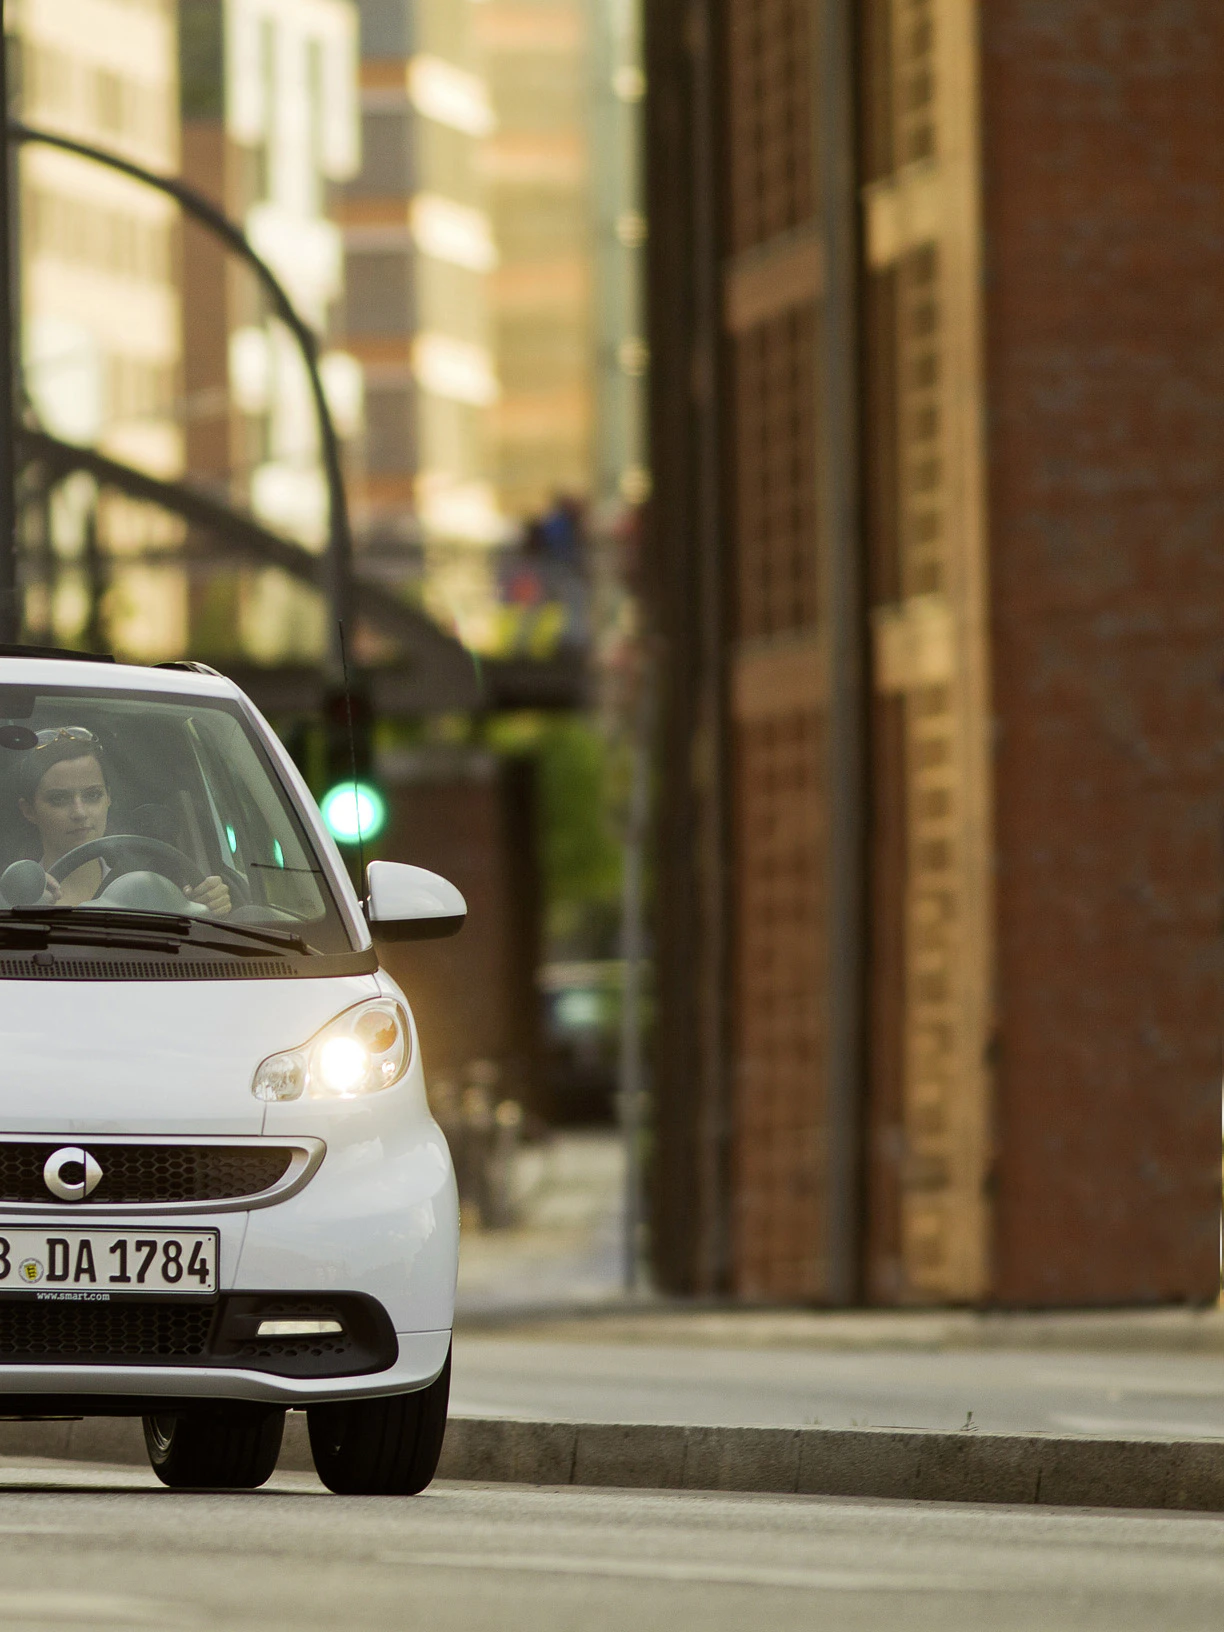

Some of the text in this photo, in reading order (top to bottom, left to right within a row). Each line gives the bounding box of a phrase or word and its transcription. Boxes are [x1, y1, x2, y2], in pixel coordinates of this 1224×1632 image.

[46, 1238, 96, 1282] DA
[109, 1240, 209, 1284] 1784
[36, 1292, 110, 1301] www.smart.com
